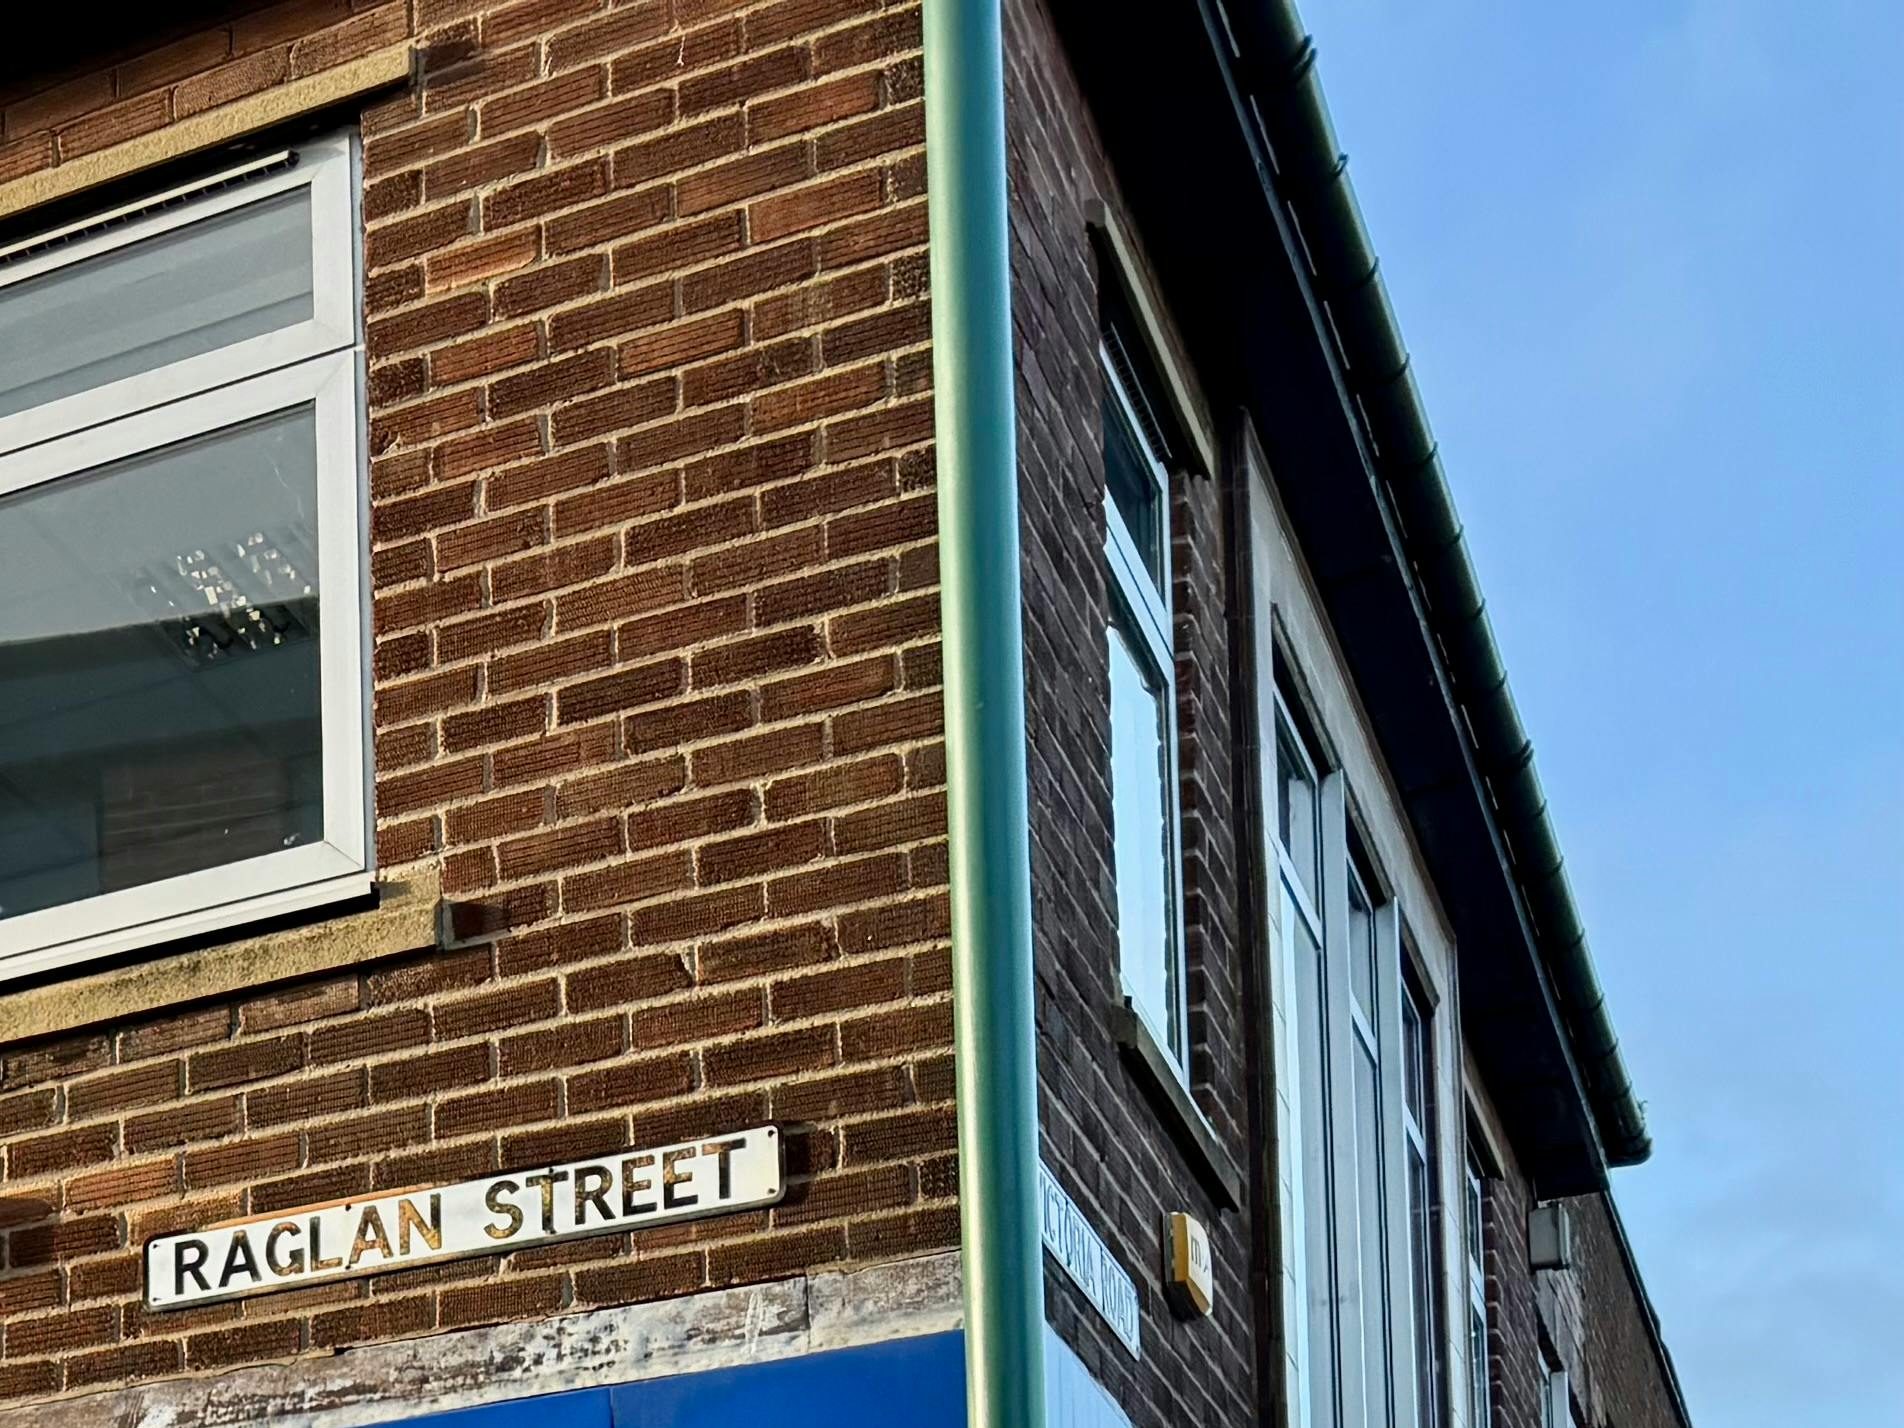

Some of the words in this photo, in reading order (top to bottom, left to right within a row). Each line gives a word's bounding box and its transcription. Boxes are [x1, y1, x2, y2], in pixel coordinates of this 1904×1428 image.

[174, 1192, 443, 1295] RAGLAN
[484, 1137, 746, 1239] STREET
[1040, 1171, 1097, 1298] ICTORIA
[1100, 1254, 1135, 1342] ROAD
